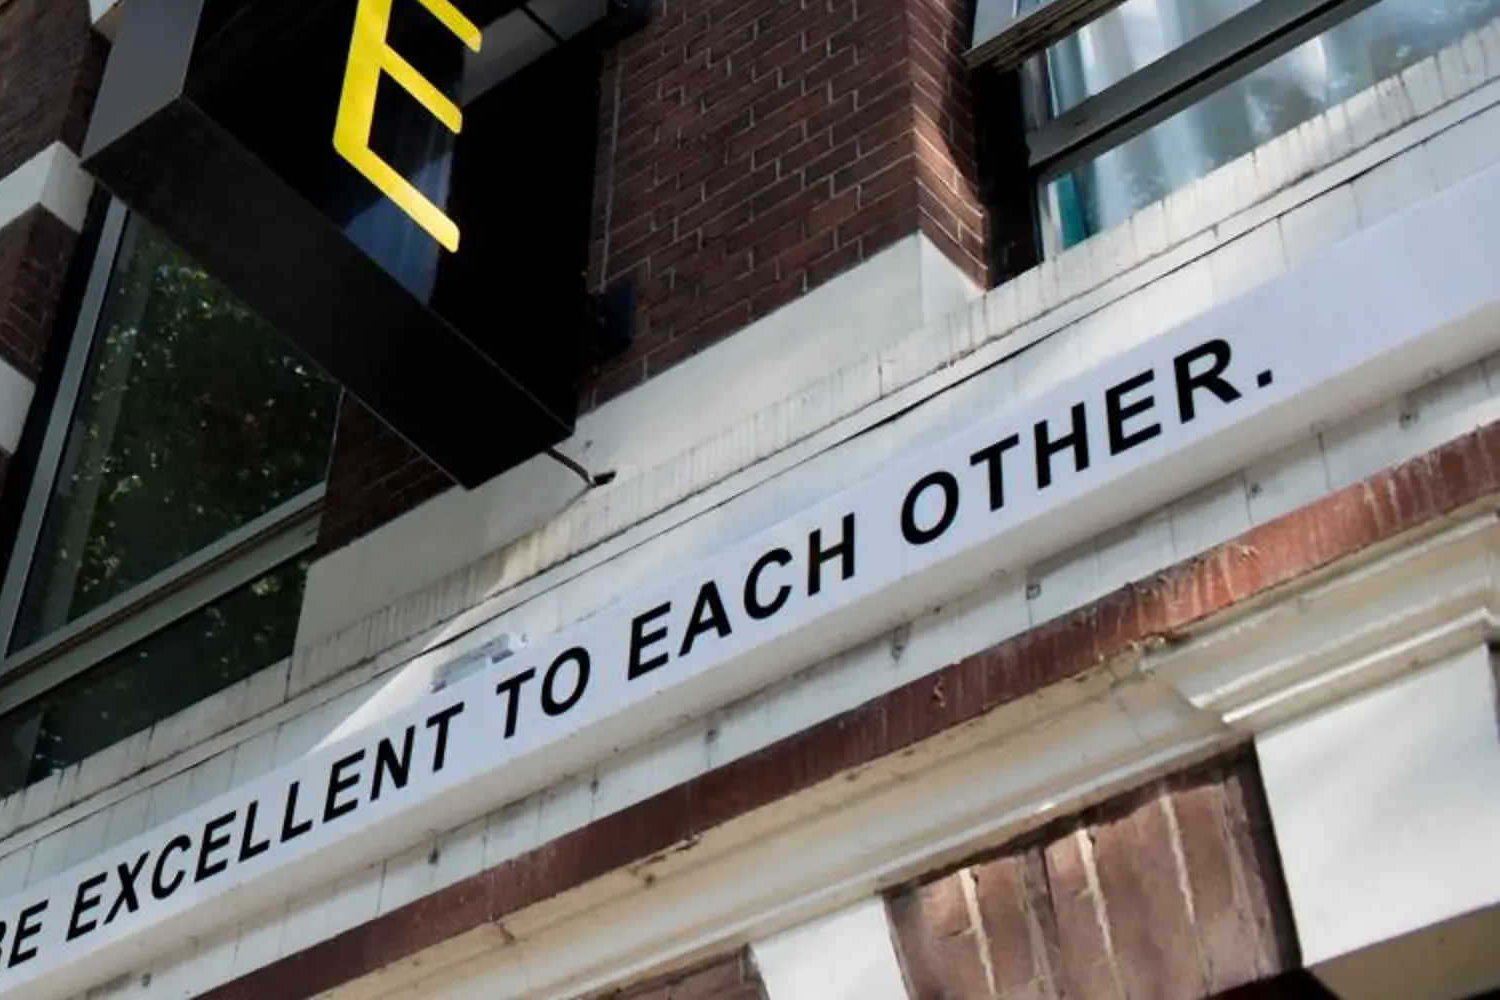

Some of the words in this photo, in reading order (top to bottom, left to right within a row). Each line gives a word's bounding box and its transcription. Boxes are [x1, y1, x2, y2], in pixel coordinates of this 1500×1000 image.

[65, 701, 465, 942] EXCELLENT
[495, 646, 591, 740] TO
[627, 512, 856, 682] EACH
[900, 337, 1274, 546] OTHER.
